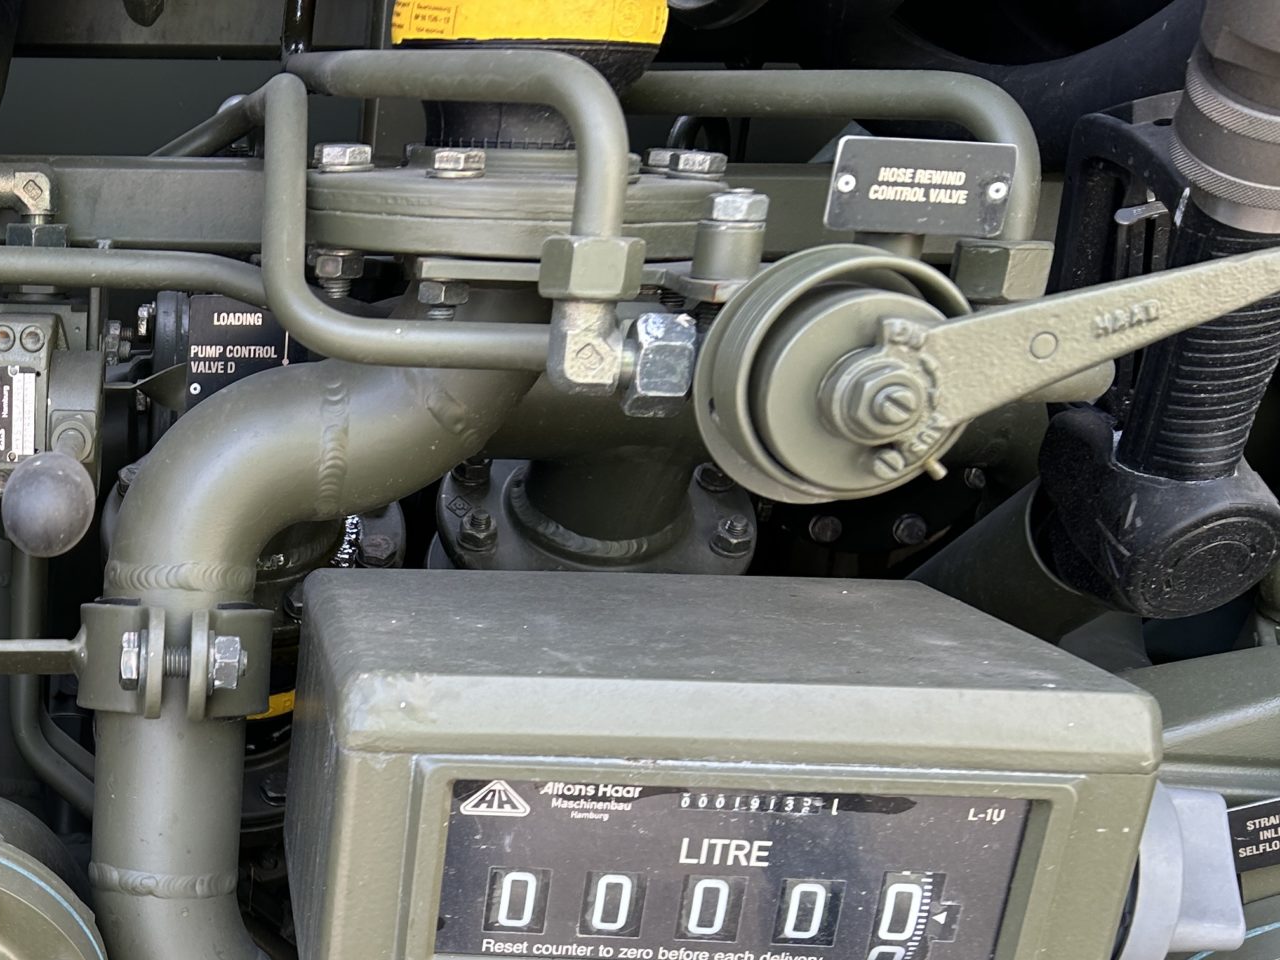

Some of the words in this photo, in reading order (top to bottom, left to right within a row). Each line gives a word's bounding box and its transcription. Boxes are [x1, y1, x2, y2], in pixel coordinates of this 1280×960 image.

[878, 167, 914, 183] HOSE
[915, 169, 966, 186] REWIND
[869, 184, 926, 202] CONTROL
[929, 188, 968, 204] VALVE
[213, 312, 263, 326] LOADING
[190, 345, 223, 358] PUMP
[226, 346, 278, 359] CONTROL
[191, 361, 224, 374] VALVE
[227, 361, 236, 374] D
[540, 782, 596, 797] Alfons
[598, 784, 642, 799] Haar
[551, 797, 632, 811] Maschinenbau
[571, 810, 609, 821] Hamburg
[968, 808, 1006, 825] L-1U
[1246, 814, 1280, 831] STRAI
[1259, 827, 1280, 840] INL
[679, 838, 773, 867] LITRE
[1238, 840, 1280, 858] SELFLO
[497, 871, 537, 928] 0
[591, 874, 632, 931] 0
[687, 878, 730, 935] 0
[783, 883, 826, 940] 0
[877, 883, 923, 941] 0
[481, 938, 528, 954] Reset
[532, 941, 595, 957] counter
[599, 943, 614, 957] to
[617, 946, 653, 960] zero
